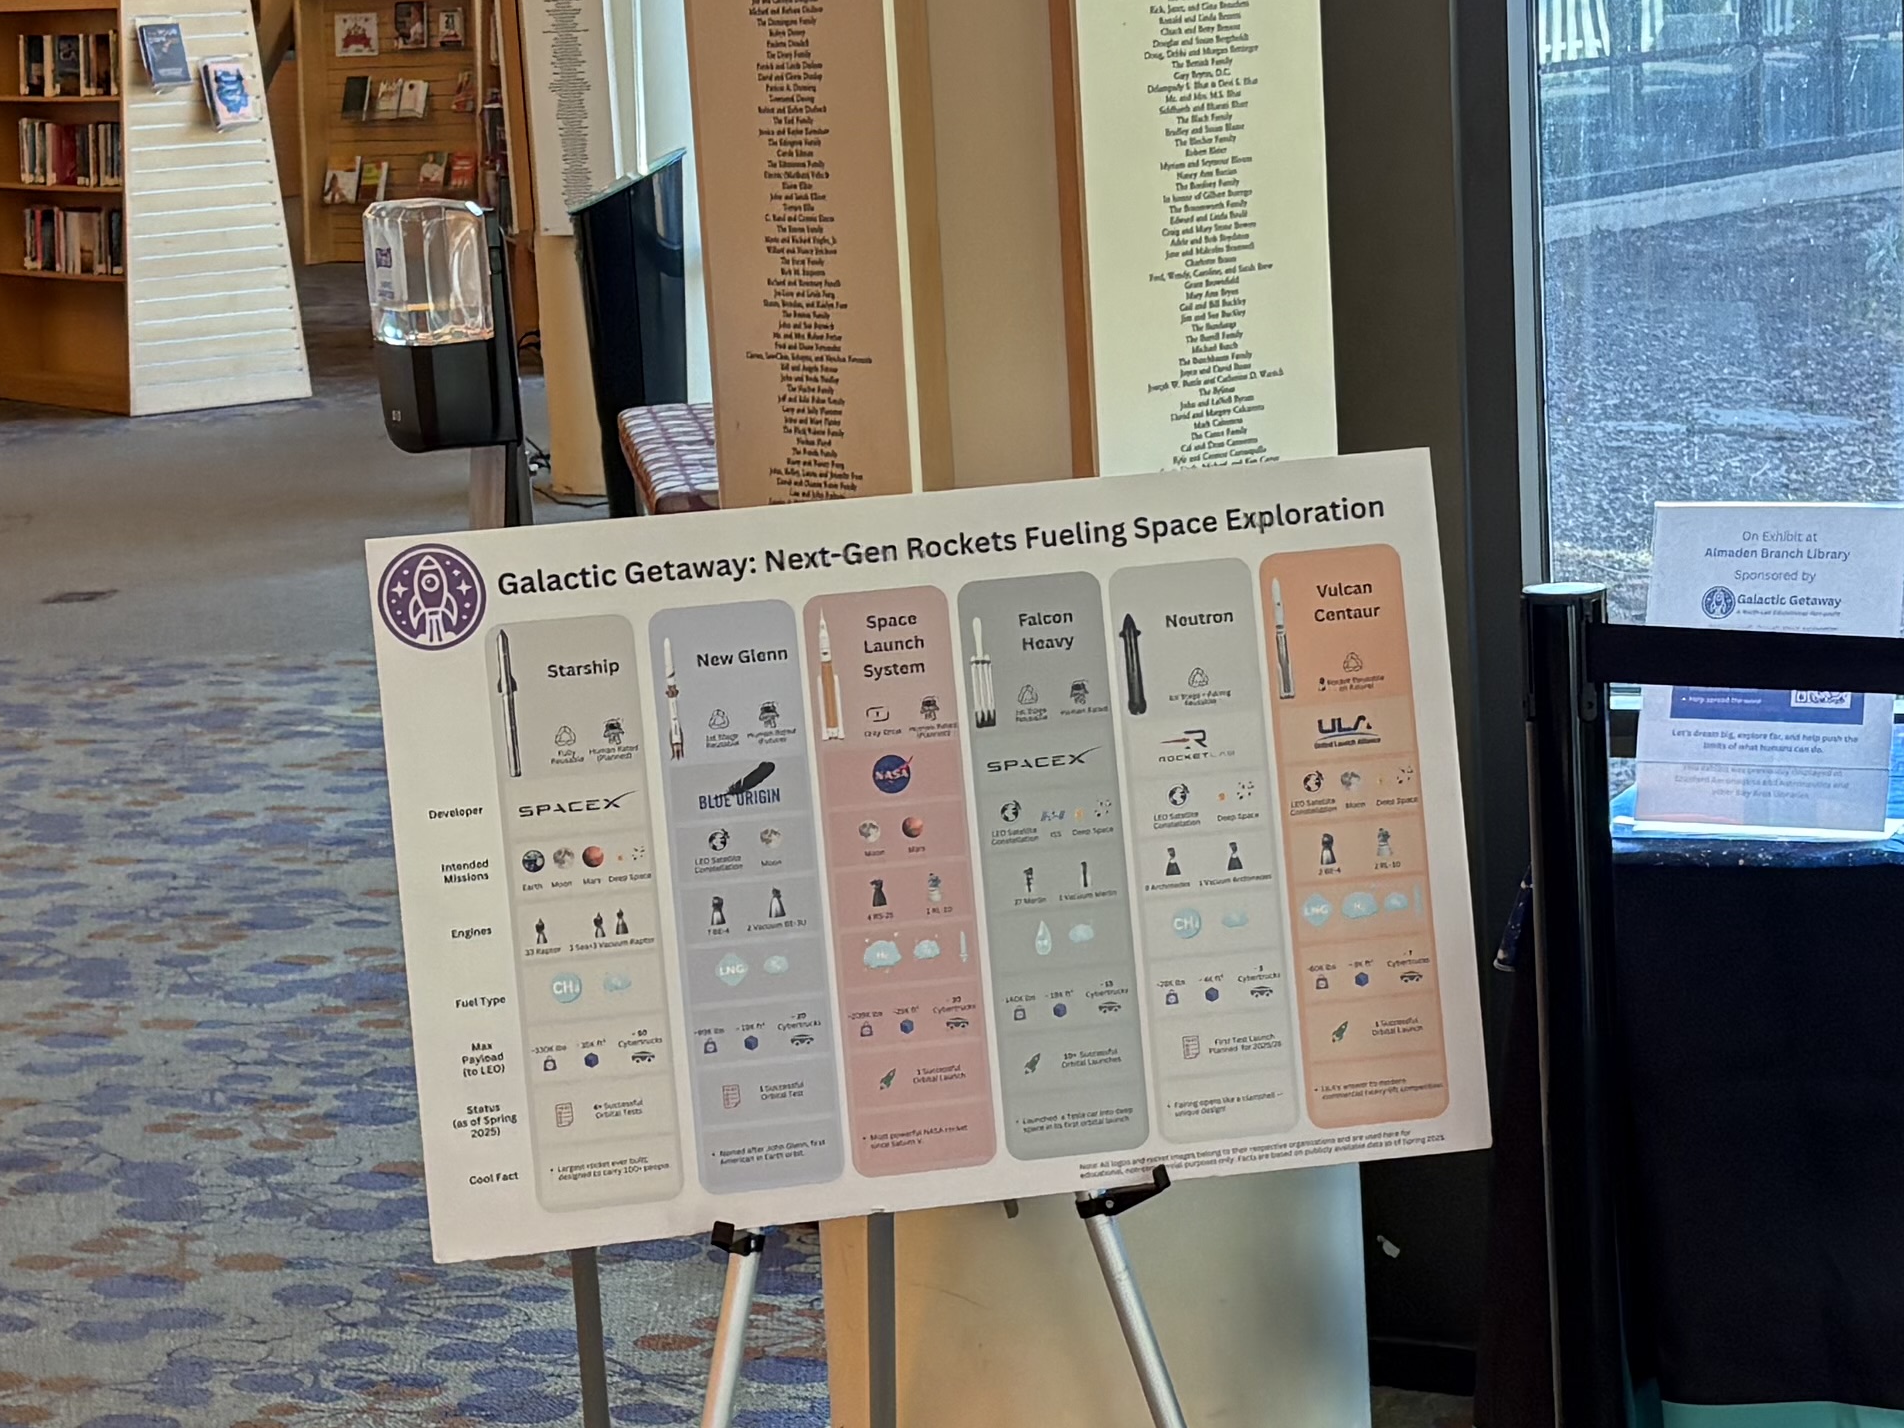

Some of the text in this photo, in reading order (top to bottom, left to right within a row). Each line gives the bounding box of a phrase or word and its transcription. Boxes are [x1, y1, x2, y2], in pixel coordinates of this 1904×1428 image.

[1742, 530, 1818, 542] On Exhibit at
[498, 496, 1385, 596] Galactic Getaway: Next-Gen Rockets Fueling Space Exploration
[1704, 547, 1850, 562] Almaden Branch Library
[1734, 570, 1816, 584] Sponsored by
[1316, 580, 1373, 599] Vulcan
[1737, 594, 1842, 609] Galactic Getaway
[1018, 609, 1073, 628] Falcon
[1165, 609, 1234, 629] Neutron
[1313, 603, 1381, 623] Centaur
[866, 612, 918, 631] Space
[864, 635, 925, 655] Launch
[1022, 634, 1075, 653] Heavy
[696, 647, 788, 668] New Glenn
[547, 658, 620, 679] Starship
[863, 659, 925, 679] System
[986, 747, 1102, 773] SPACEX
[874, 765, 910, 782] NASA
[518, 791, 637, 818] SPACEX
[698, 788, 781, 810] BLUE ORIGIN
[428, 806, 484, 820] Developer
[441, 859, 489, 873] Intended
[444, 872, 489, 884] Missions
[451, 927, 492, 940] Engines
[455, 996, 506, 1009] Fuel Type
[471, 1042, 493, 1052] Max
[462, 1052, 504, 1067] Payload
[463, 1063, 505, 1078] (to LEO)
[466, 1104, 500, 1115] Status
[452, 1113, 518, 1129] (as of Spring
[471, 1126, 501, 1138] 2025)
[469, 1172, 519, 1185] Cool Fact
